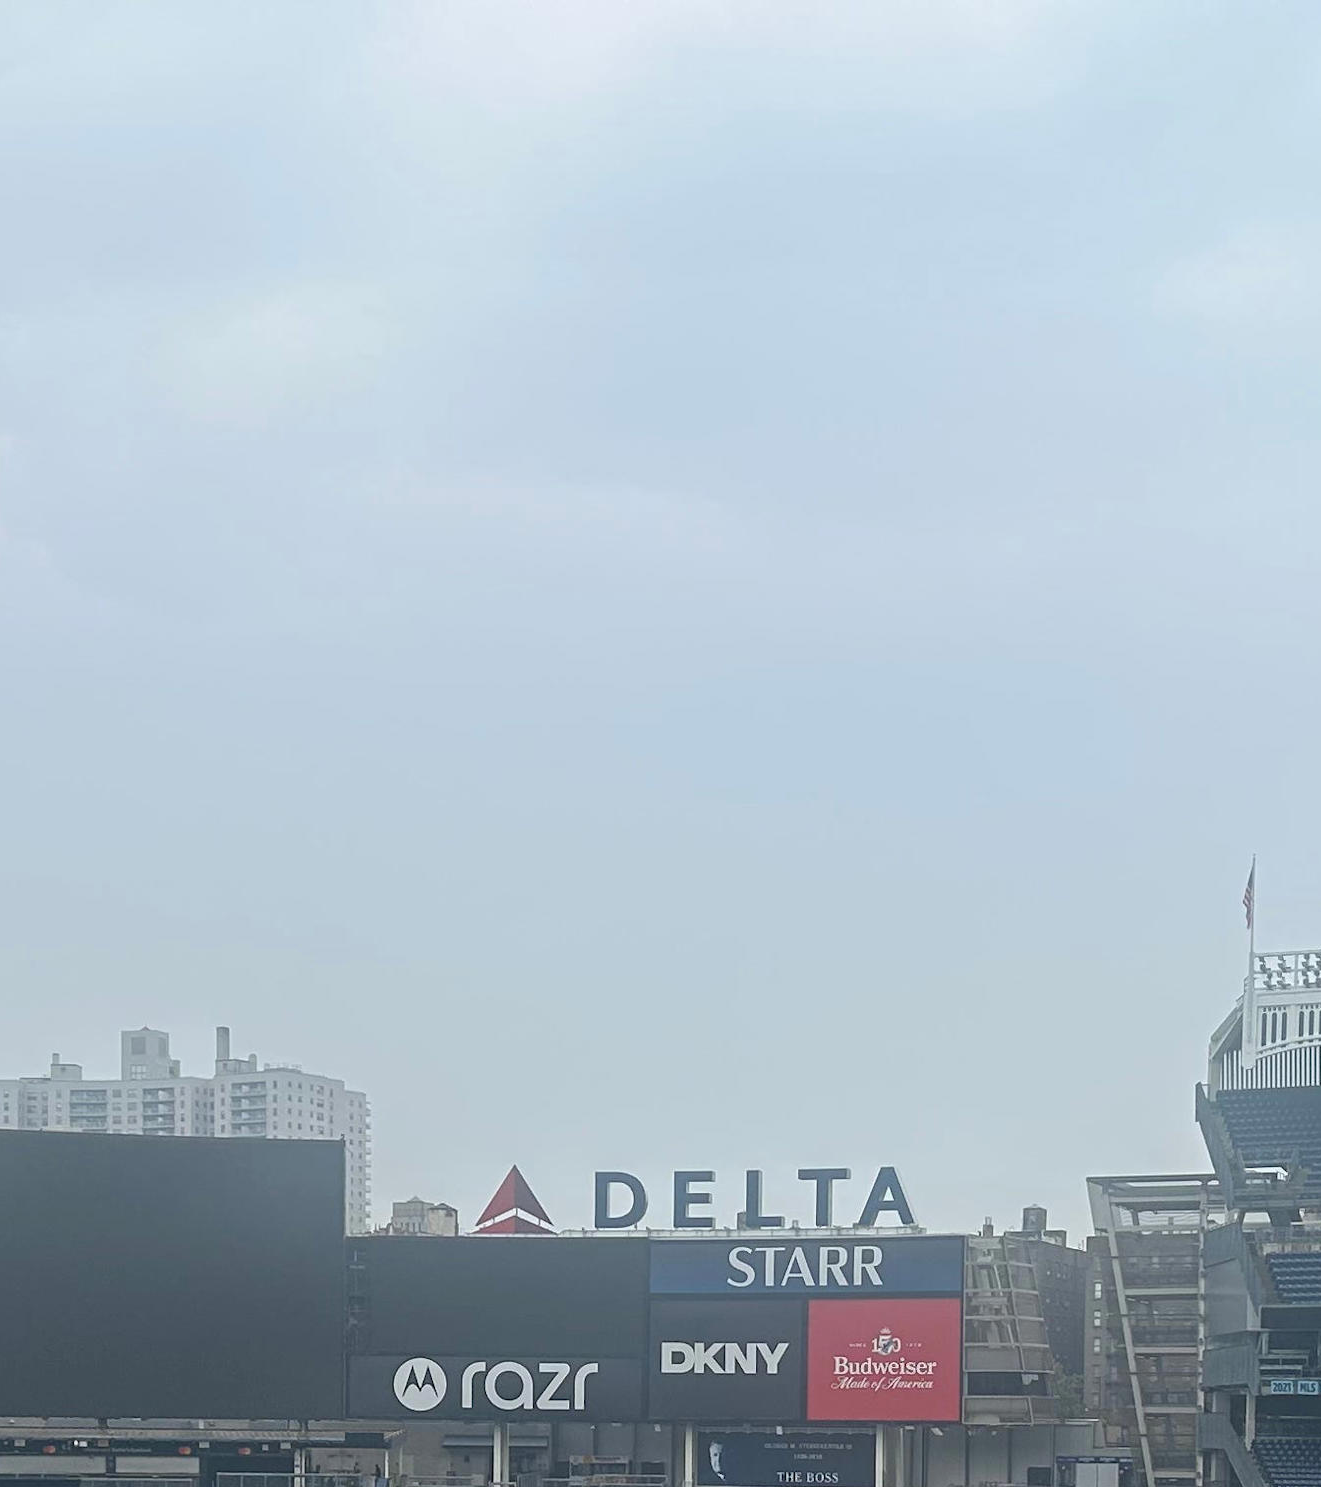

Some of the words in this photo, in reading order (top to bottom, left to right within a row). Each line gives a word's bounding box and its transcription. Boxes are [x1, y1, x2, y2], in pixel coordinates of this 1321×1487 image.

[593, 1166, 915, 1228] DELTA
[726, 1246, 884, 1287] STARR
[660, 1341, 790, 1374] DKNY
[833, 1356, 937, 1375] Budweiser
[462, 1361, 599, 1411] razr
[831, 1376, 871, 1389] Made
[871, 1377, 886, 1392] of
[882, 1376, 934, 1389] America
[1273, 1382, 1292, 1392] 2021
[1300, 1382, 1316, 1392] MLS
[777, 1471, 802, 1483] THE
[806, 1472, 839, 1483] BOSS
